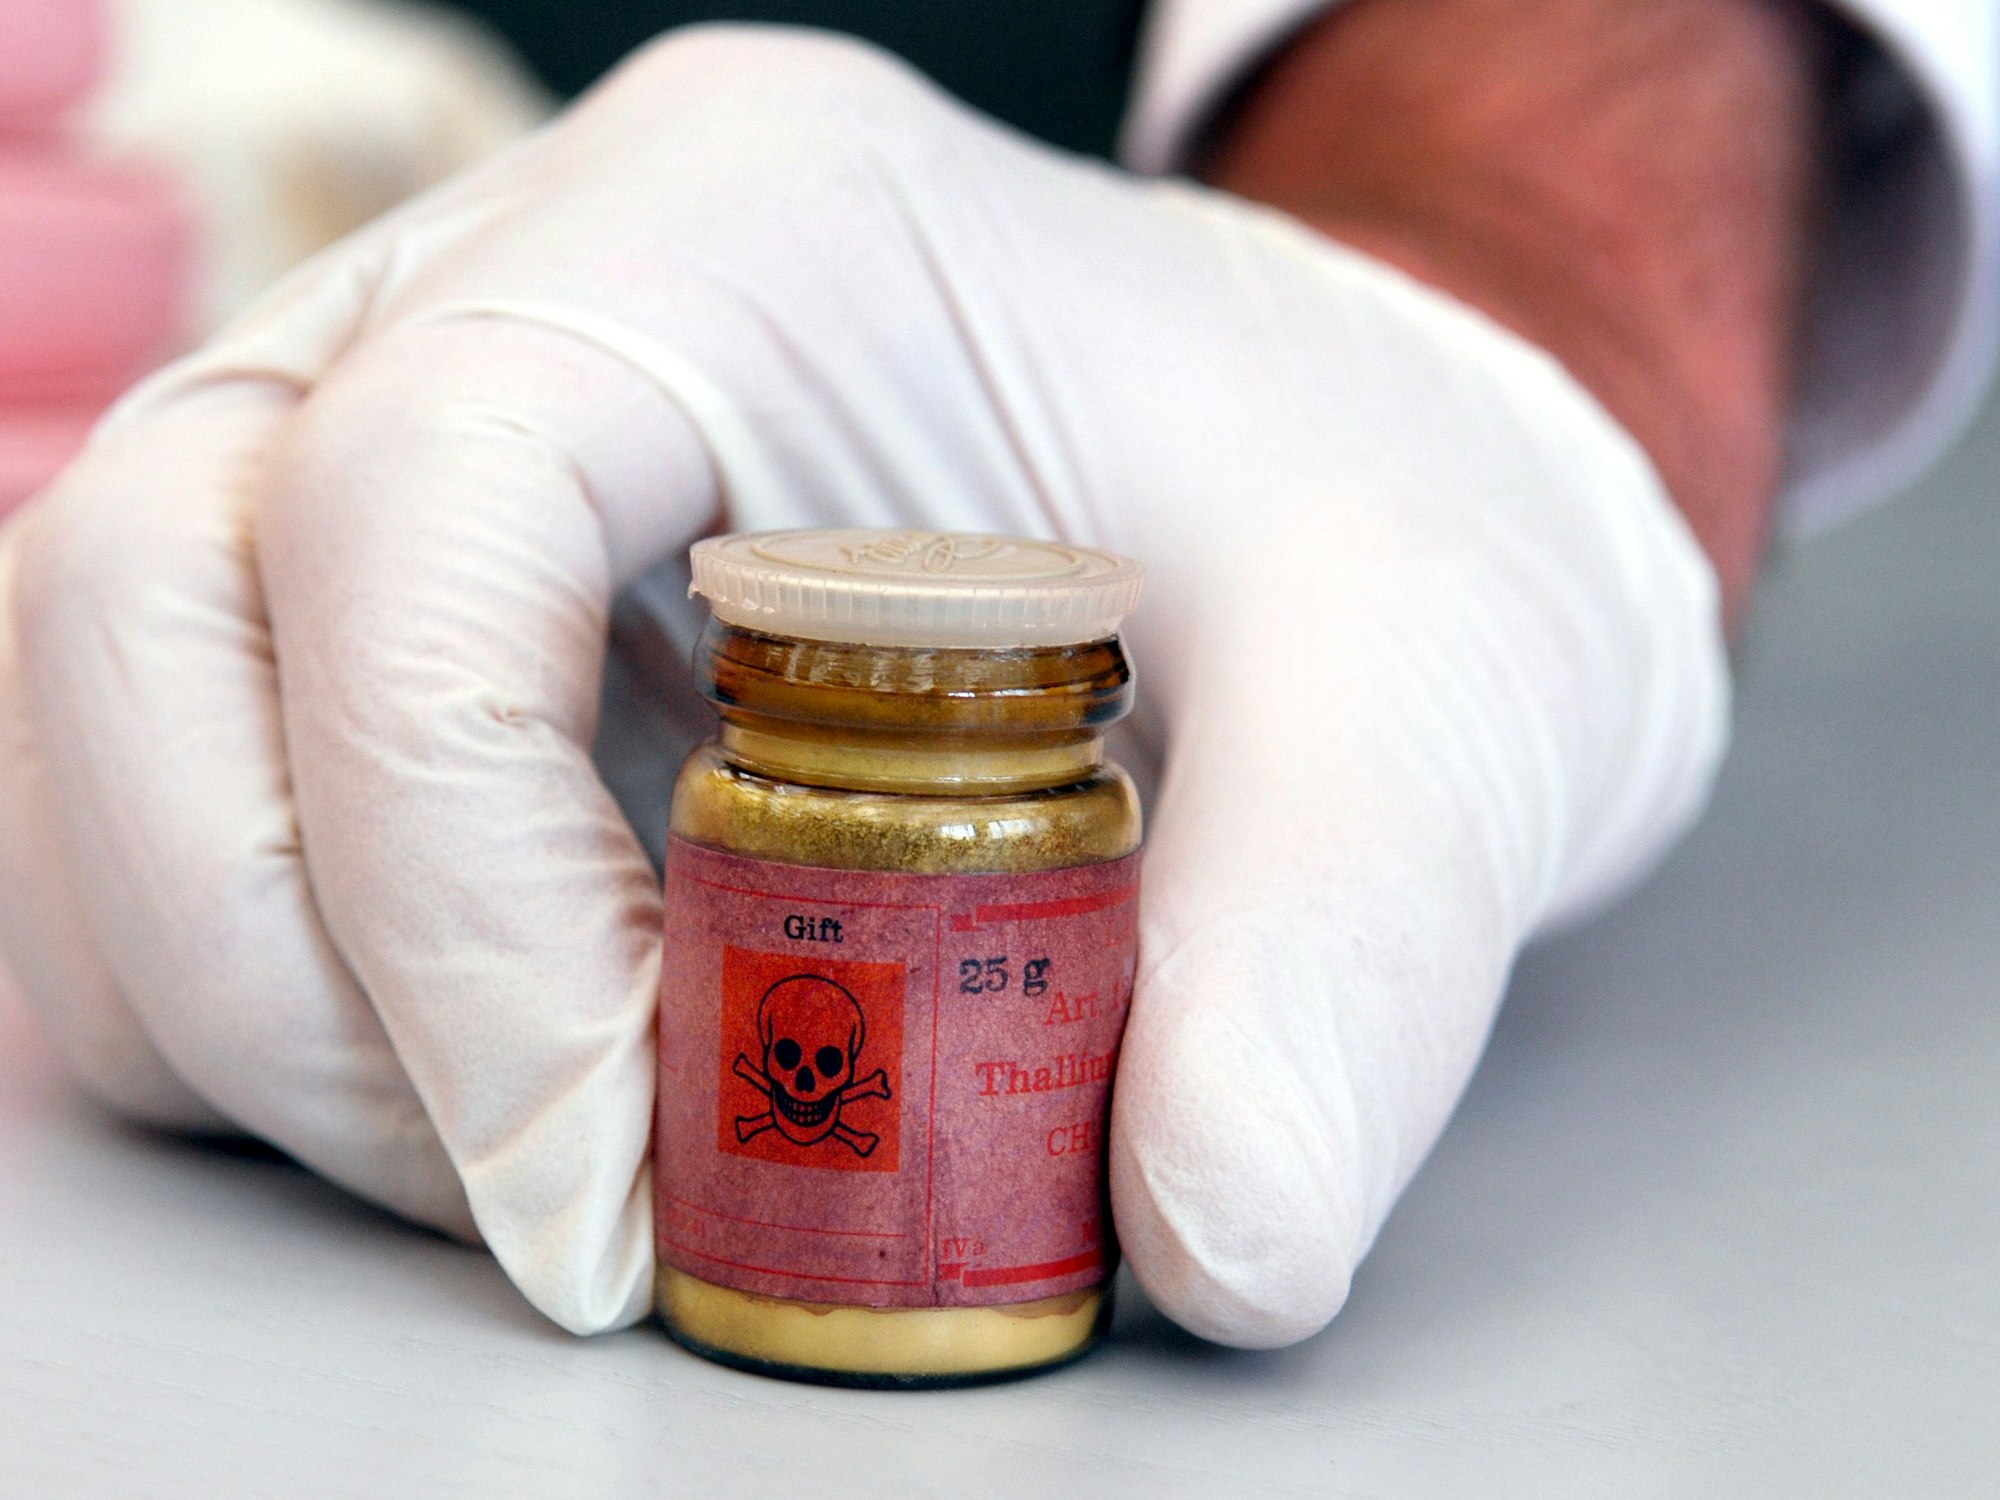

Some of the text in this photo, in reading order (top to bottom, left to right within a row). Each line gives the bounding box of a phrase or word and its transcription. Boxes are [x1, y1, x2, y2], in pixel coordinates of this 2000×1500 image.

[784, 914, 844, 943] Gift
[959, 955, 1053, 996] 25 g
